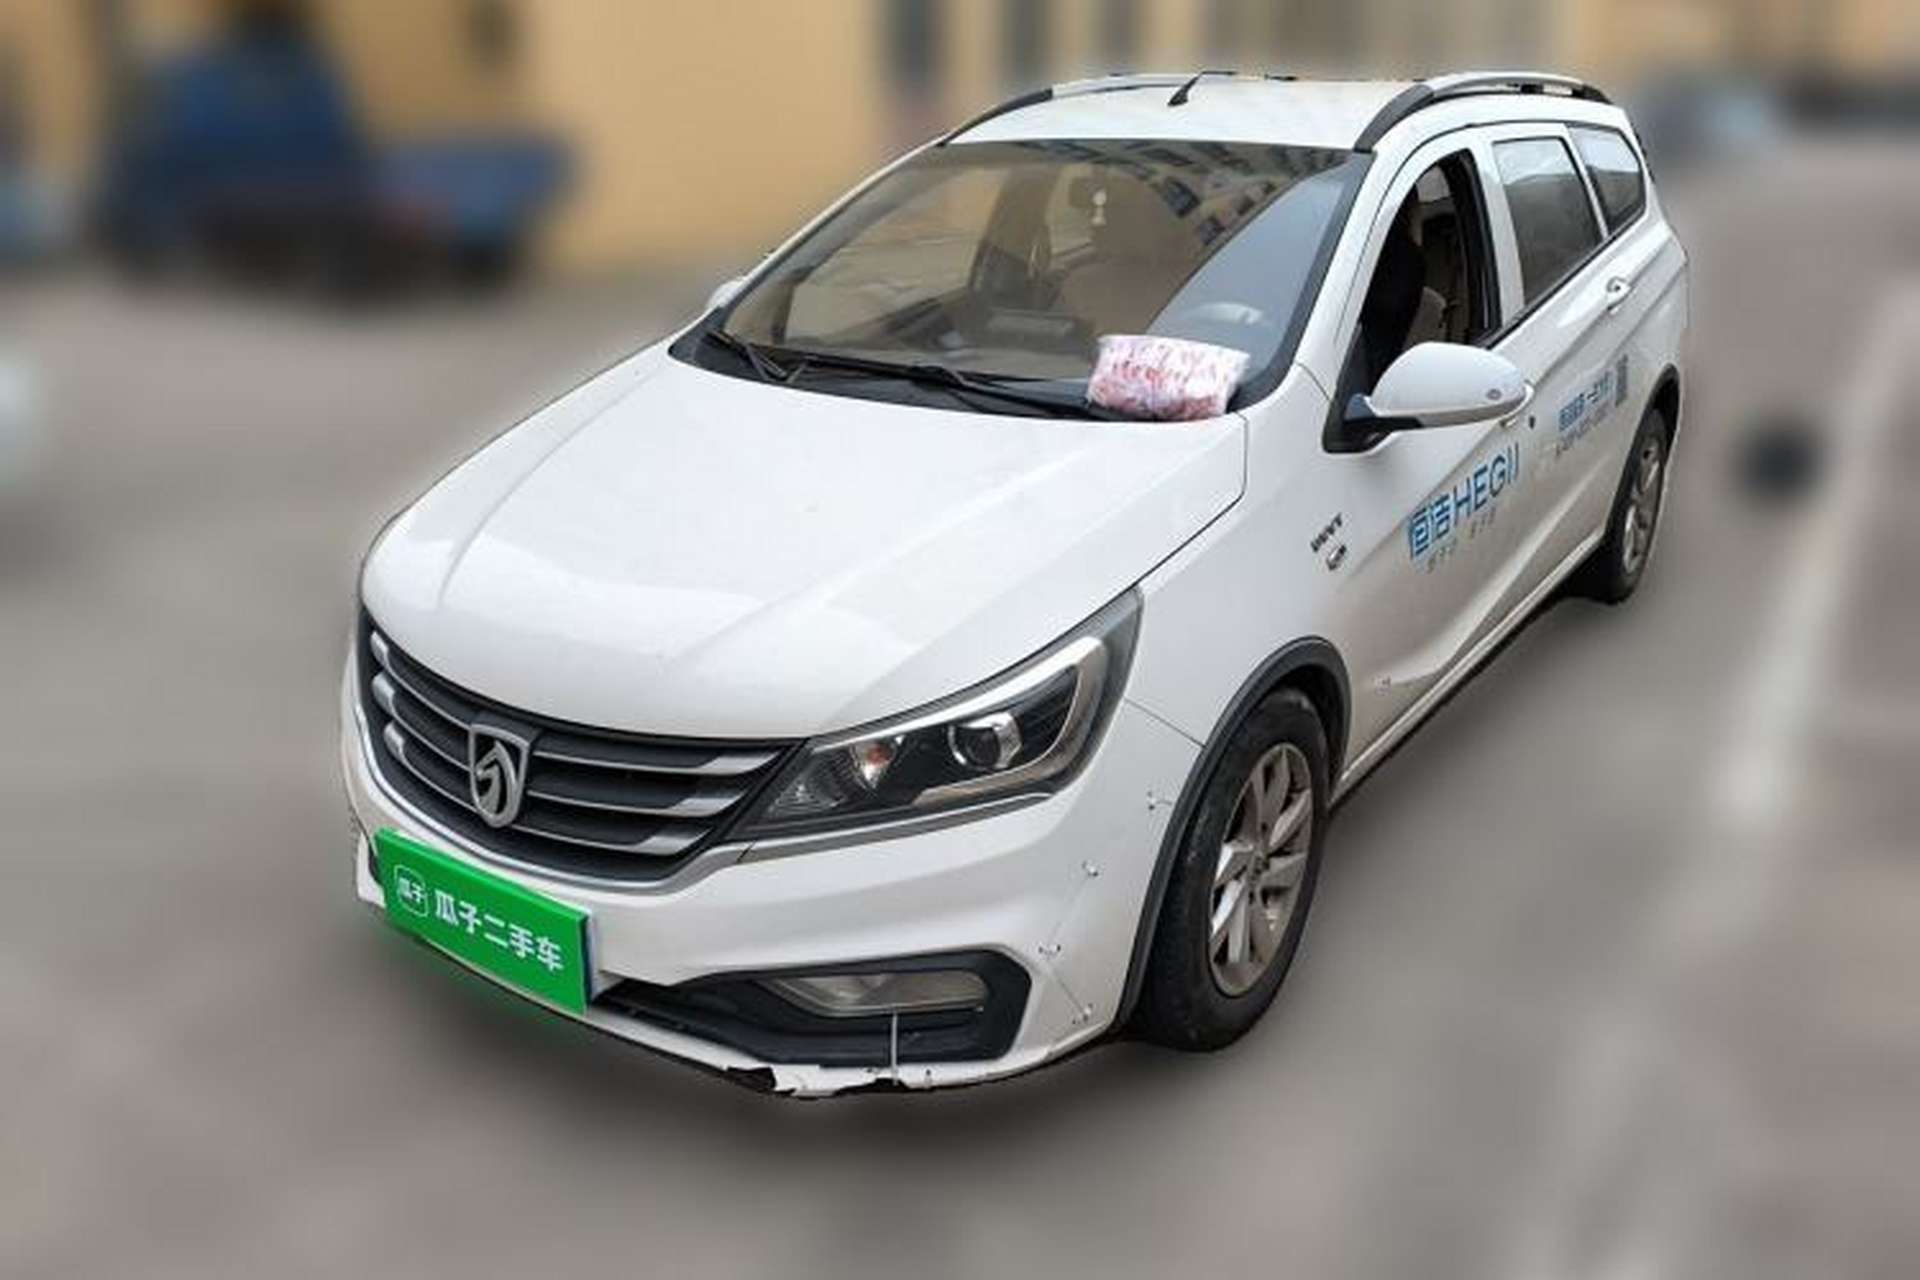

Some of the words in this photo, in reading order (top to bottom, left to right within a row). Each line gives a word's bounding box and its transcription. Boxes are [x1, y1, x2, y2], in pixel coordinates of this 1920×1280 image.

[435, 889, 564, 972] 瓜子二手车
